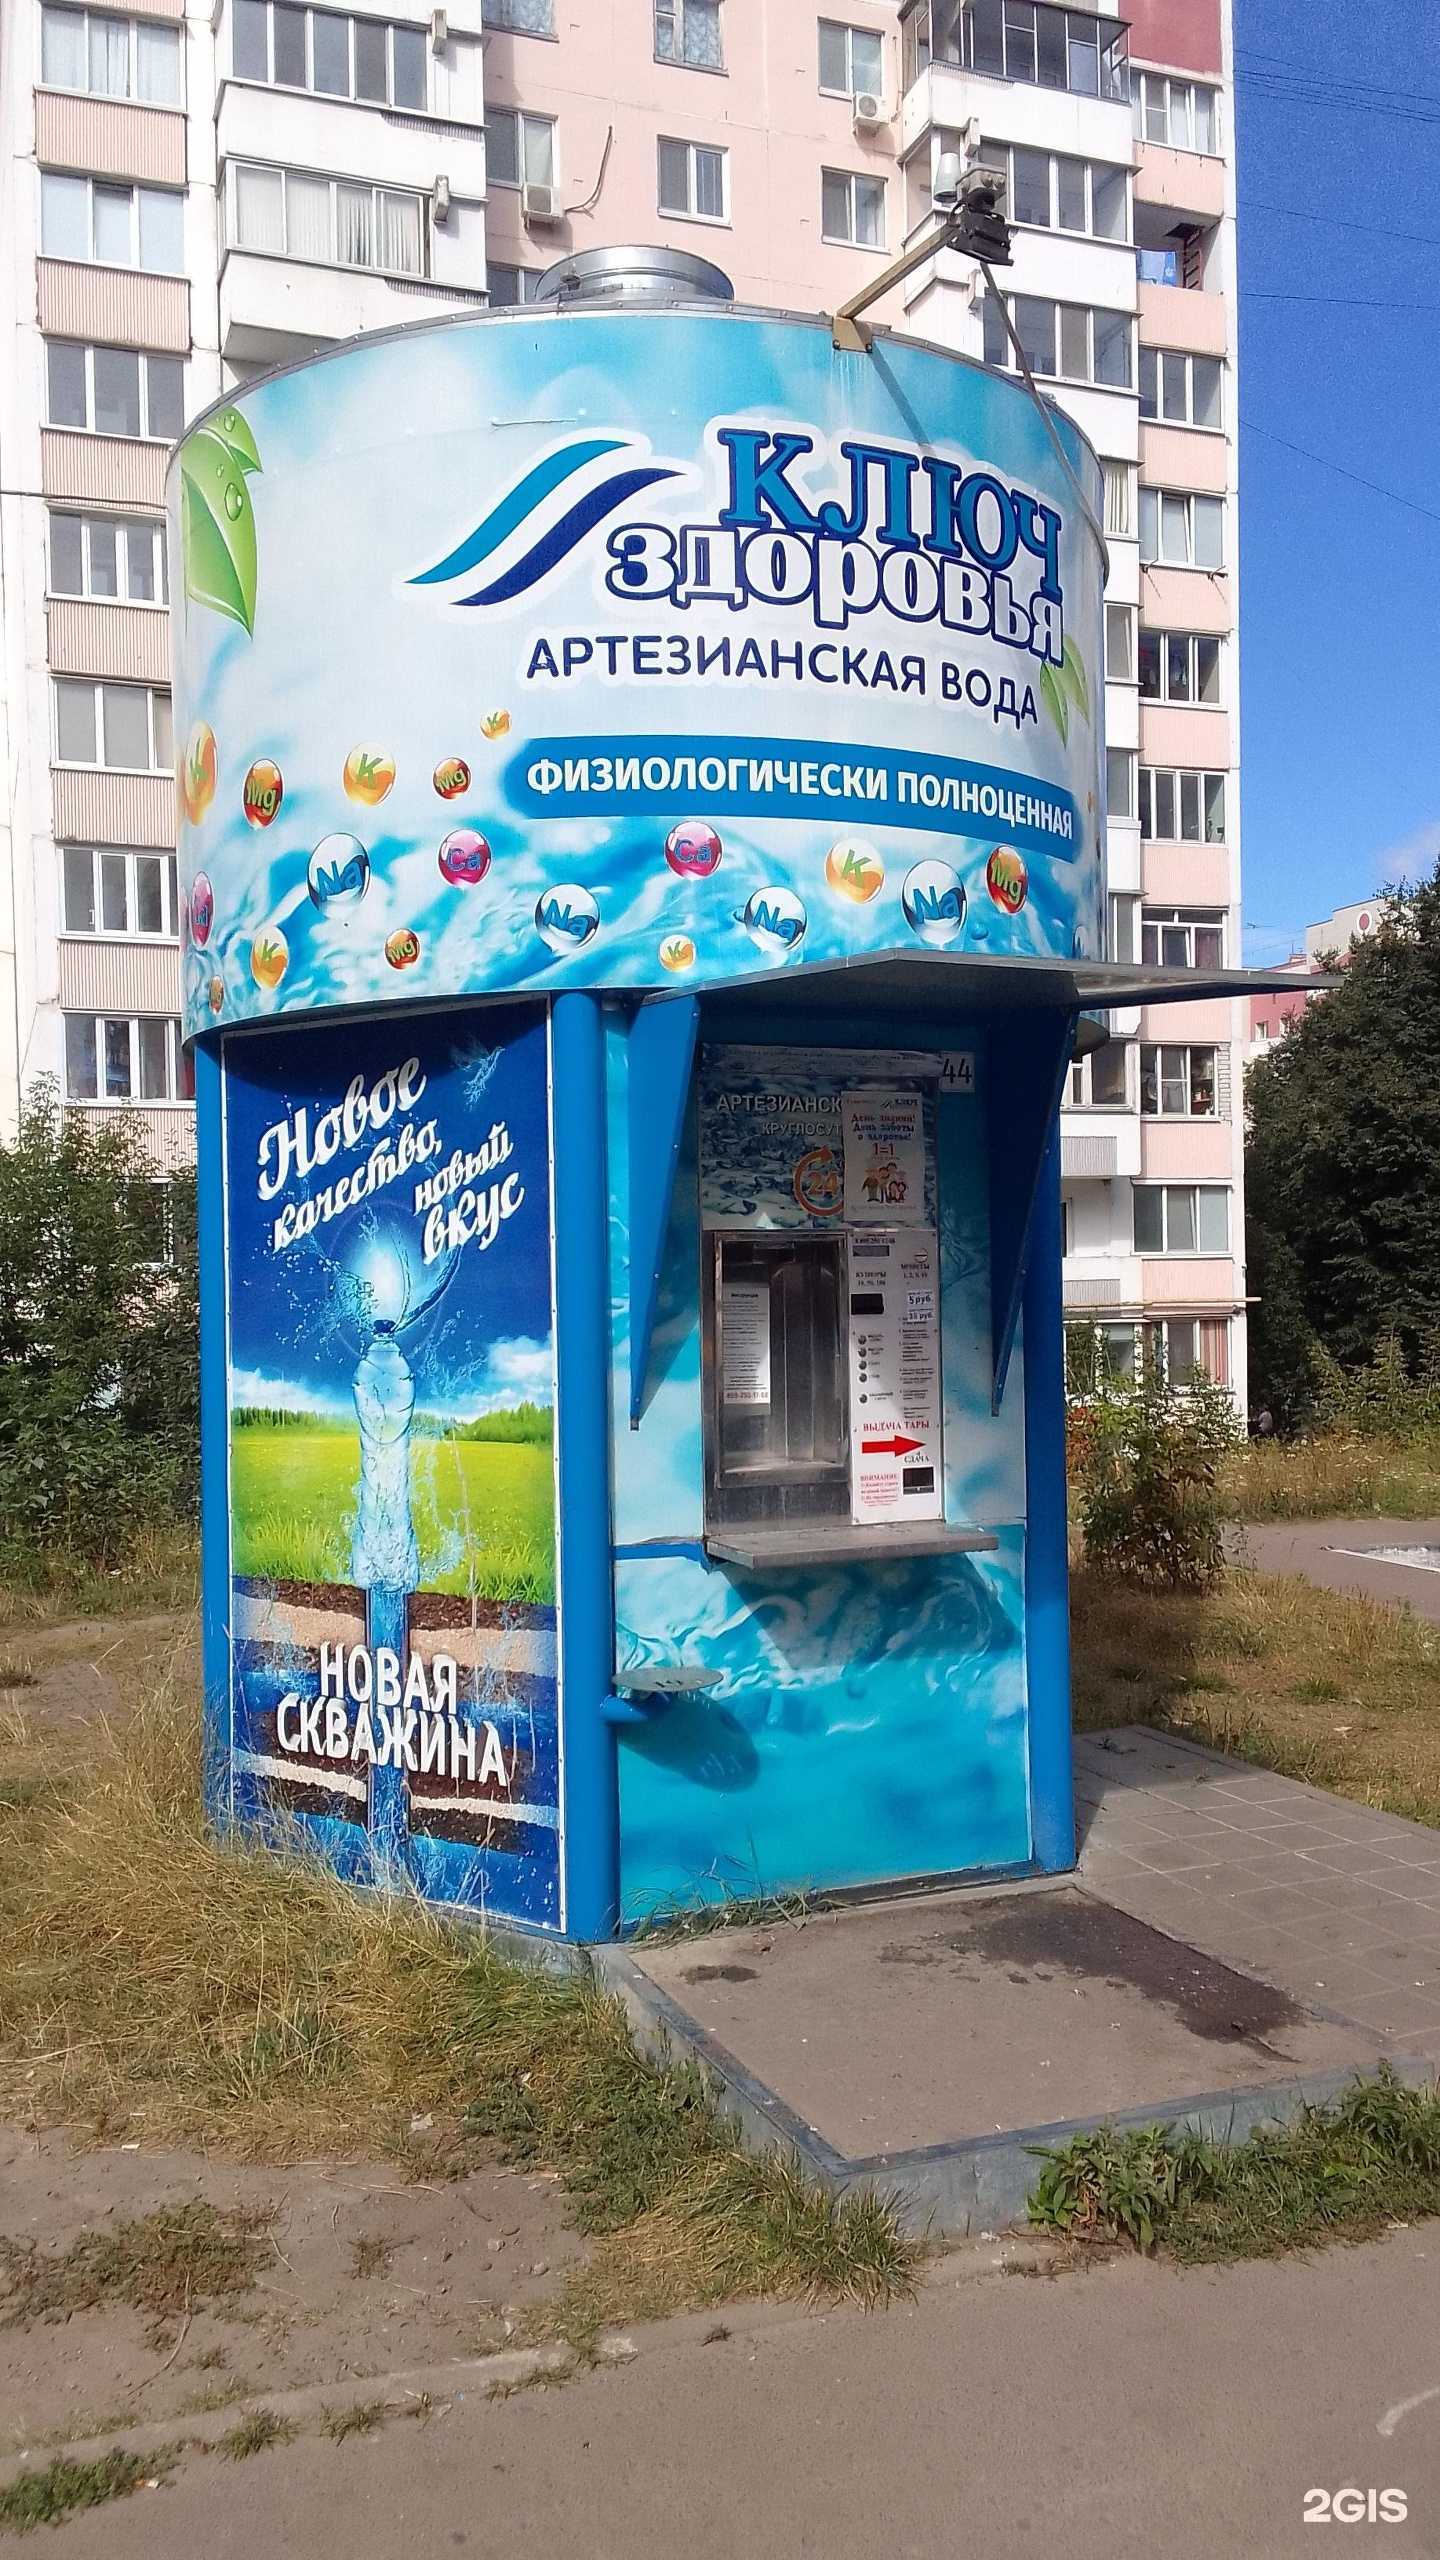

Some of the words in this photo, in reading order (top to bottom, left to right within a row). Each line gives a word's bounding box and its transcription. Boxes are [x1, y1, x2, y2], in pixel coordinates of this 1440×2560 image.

[717, 428, 1065, 597] КЛЮЧ
[526, 635, 926, 695] АРТЕЗИАНСКАЯ
[941, 664, 1038, 731] ВОДА
[356, 753, 384, 790] K
[437, 767, 467, 792] Mg
[246, 777, 277, 816] Mg
[526, 756, 888, 801] ФИЗИОЛОГИЧЕСКИ
[897, 771, 1073, 840] ПОЛНОЦЕННАЯ
[447, 848, 482, 872] Ca
[676, 837, 712, 864] Ca
[841, 848, 871, 887] K
[315, 860, 363, 900] Na
[991, 858, 1022, 904] Mg
[543, 898, 589, 937] Na
[751, 905, 795, 939] Na
[914, 884, 963, 923] Na
[387, 939, 415, 963] Mg
[942, 1058, 973, 1084] 44
[257, 1056, 427, 1201] Новое
[273, 1119, 442, 1254] качество,
[413, 1120, 514, 1216] новый
[806, 1170, 839, 1196] 24
[423, 1172, 525, 1265] вкус
[904, 1420, 930, 1430] ТАРЫ
[319, 1641, 457, 1714] НОВАЯ
[277, 1692, 508, 1787] СКВАЖИНА
